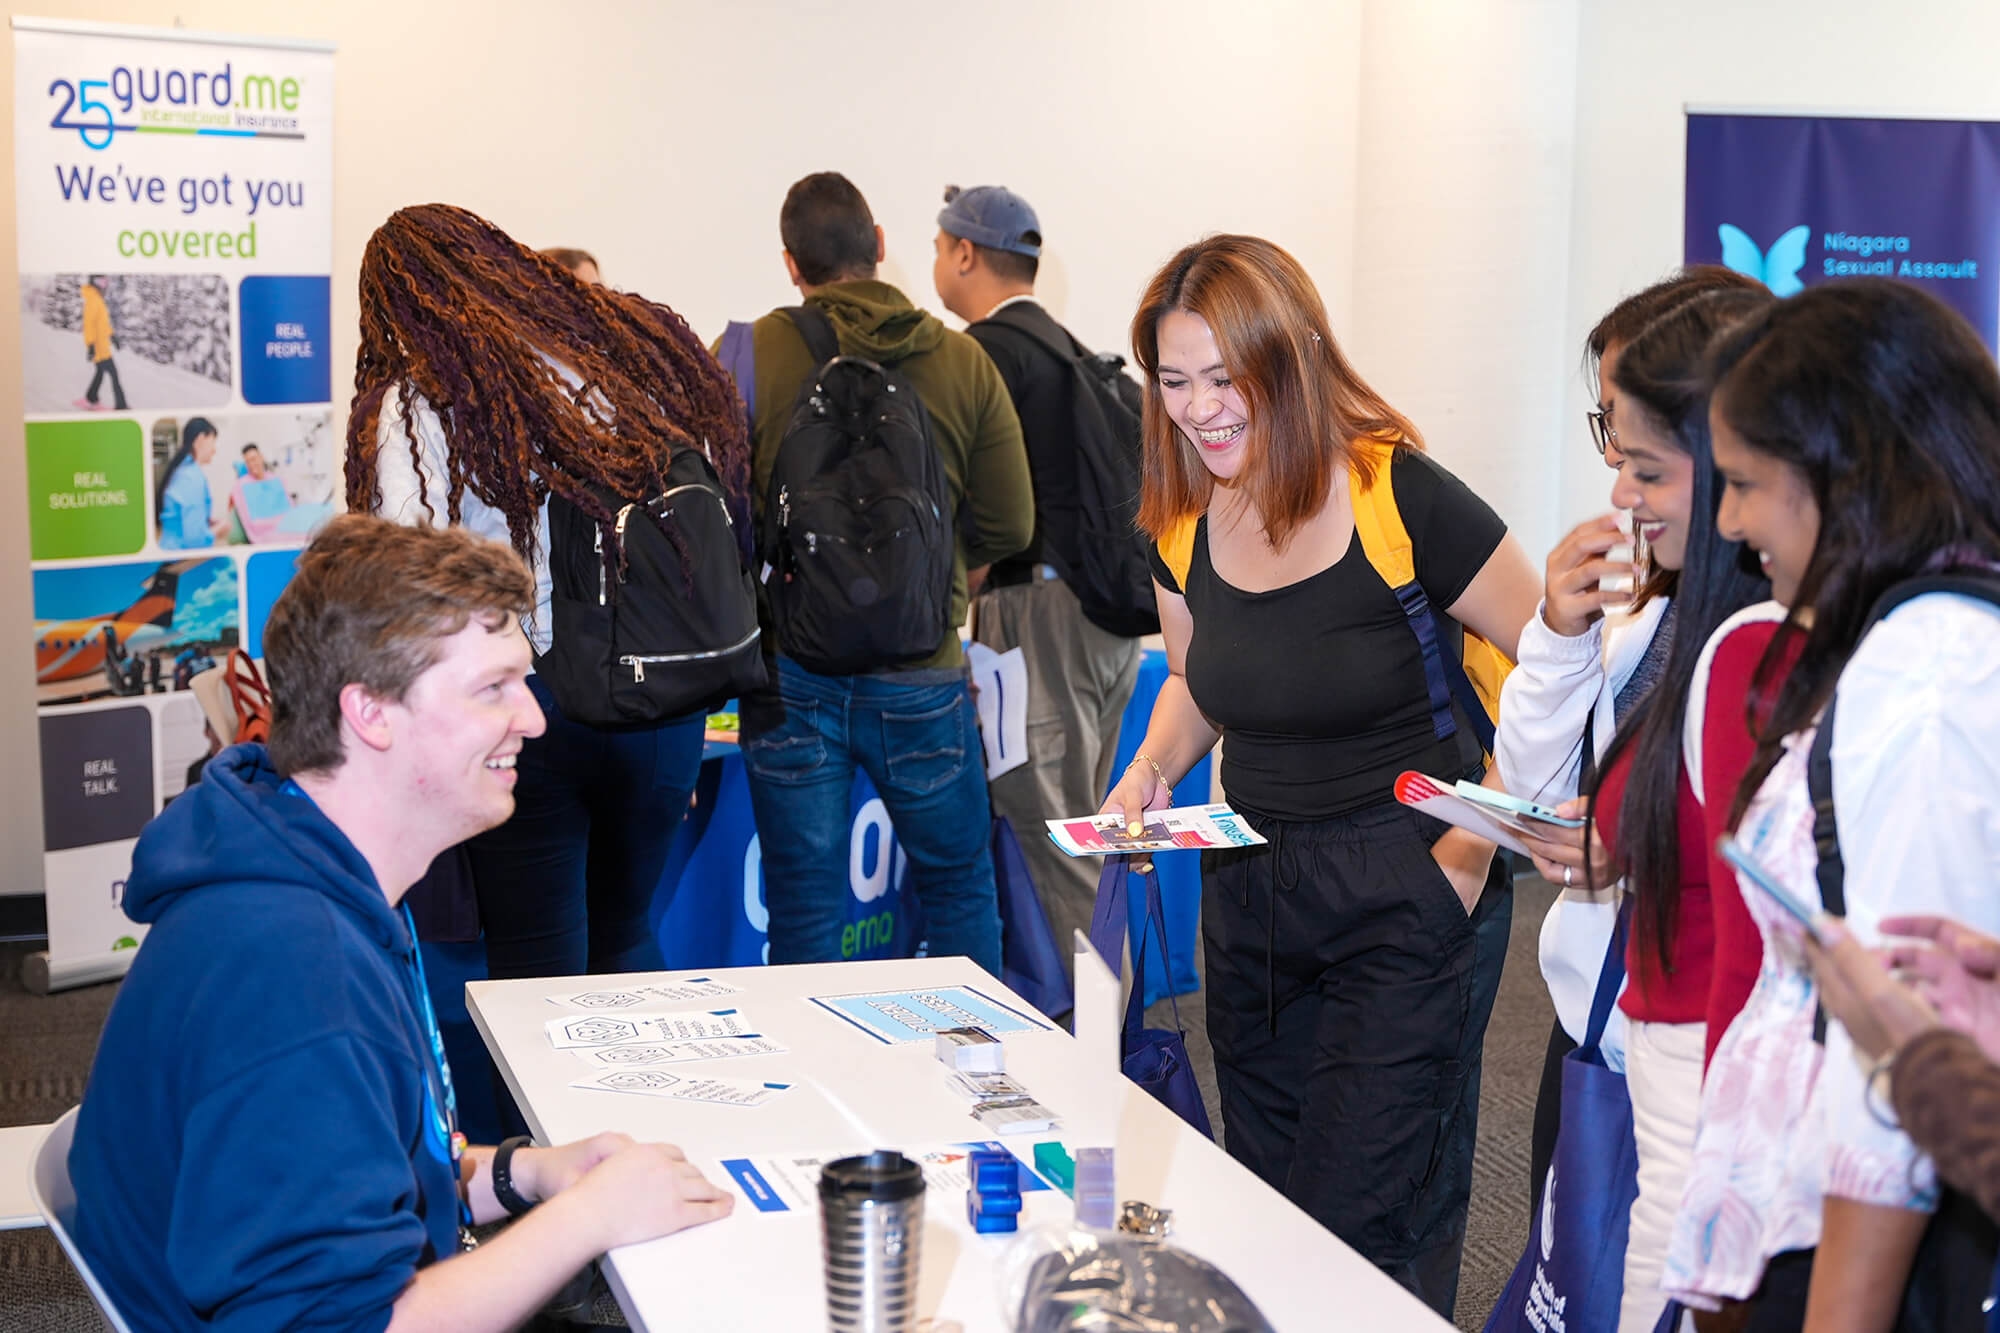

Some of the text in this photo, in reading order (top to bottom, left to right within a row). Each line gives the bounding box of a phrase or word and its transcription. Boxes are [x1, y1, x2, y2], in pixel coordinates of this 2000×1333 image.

[56, 164, 303, 216] We've got you
[117, 221, 257, 258] covered
[1823, 232, 1910, 257] Niagara
[1823, 257, 1979, 279] Sexual Assault
[275, 322, 306, 339] REAL
[265, 341, 313, 358] PEOPLE
[73, 472, 109, 488] REAL
[49, 490, 128, 509] SOLUTIONS
[83, 760, 118, 777] REAL
[82, 778, 119, 797] TALK
